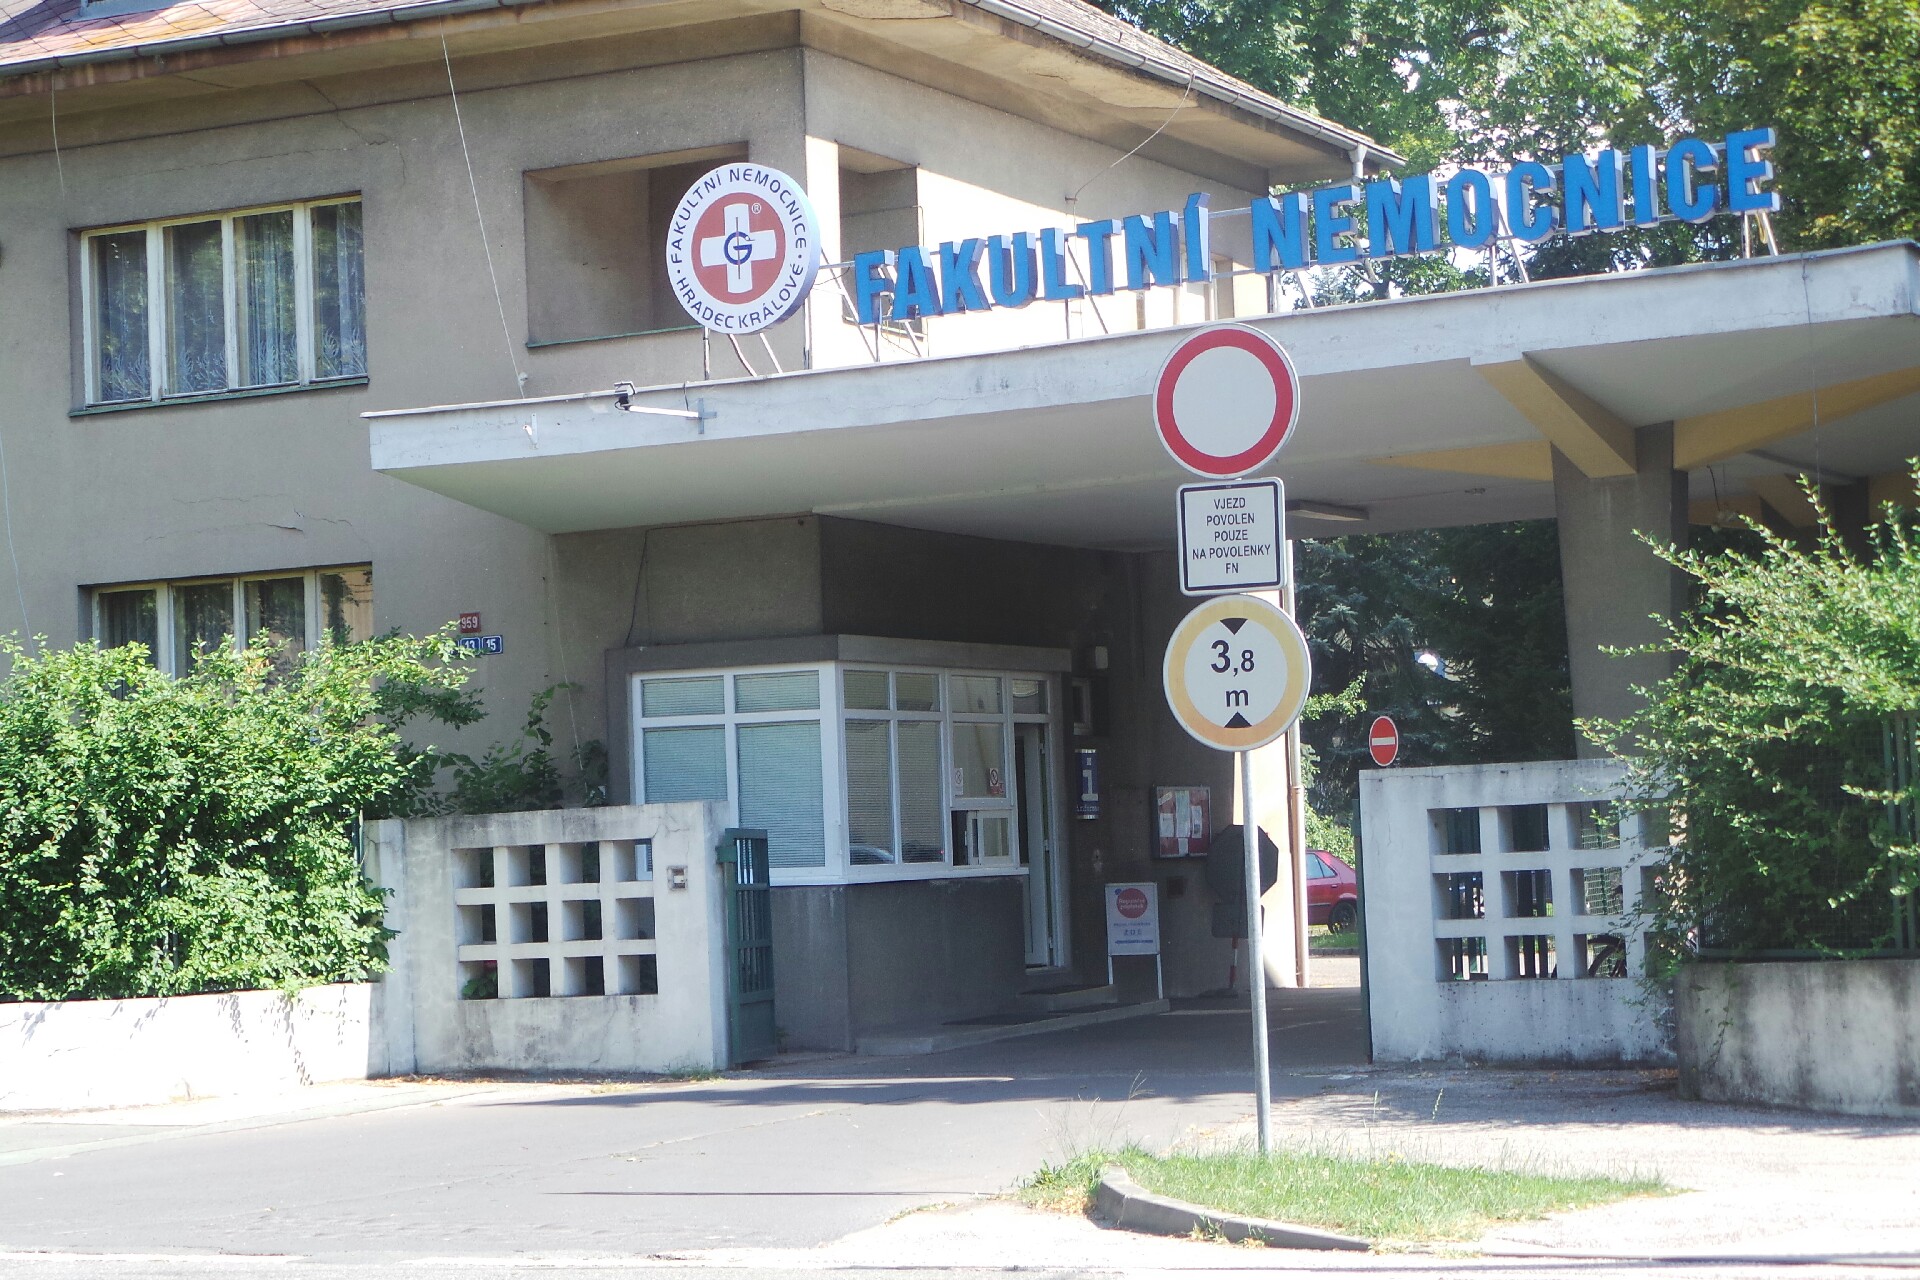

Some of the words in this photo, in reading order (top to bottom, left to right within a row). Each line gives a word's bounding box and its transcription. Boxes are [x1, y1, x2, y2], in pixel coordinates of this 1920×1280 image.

[670, 169, 722, 265] FAKULTNÍ
[729, 167, 807, 249] NEMOCNICE
[854, 191, 1212, 325] FAKULTNÍ
[1251, 127, 1780, 274] NEMOCNICE
[676, 277, 734, 329] HRADEC
[738, 262, 804, 329] KRÁLOVÉ
[1213, 497, 1246, 510] VJEZD
[1206, 512, 1255, 526] POVOLEN
[1214, 529, 1249, 542] POUZE
[1192, 548, 1207, 560] NA
[1209, 543, 1271, 559] POVOLENKY
[1225, 562, 1239, 574] FN
[461, 616, 478, 629] 959
[486, 638, 496, 651] 15
[1210, 639, 1255, 677] 3,8
[1226, 689, 1249, 707] m
